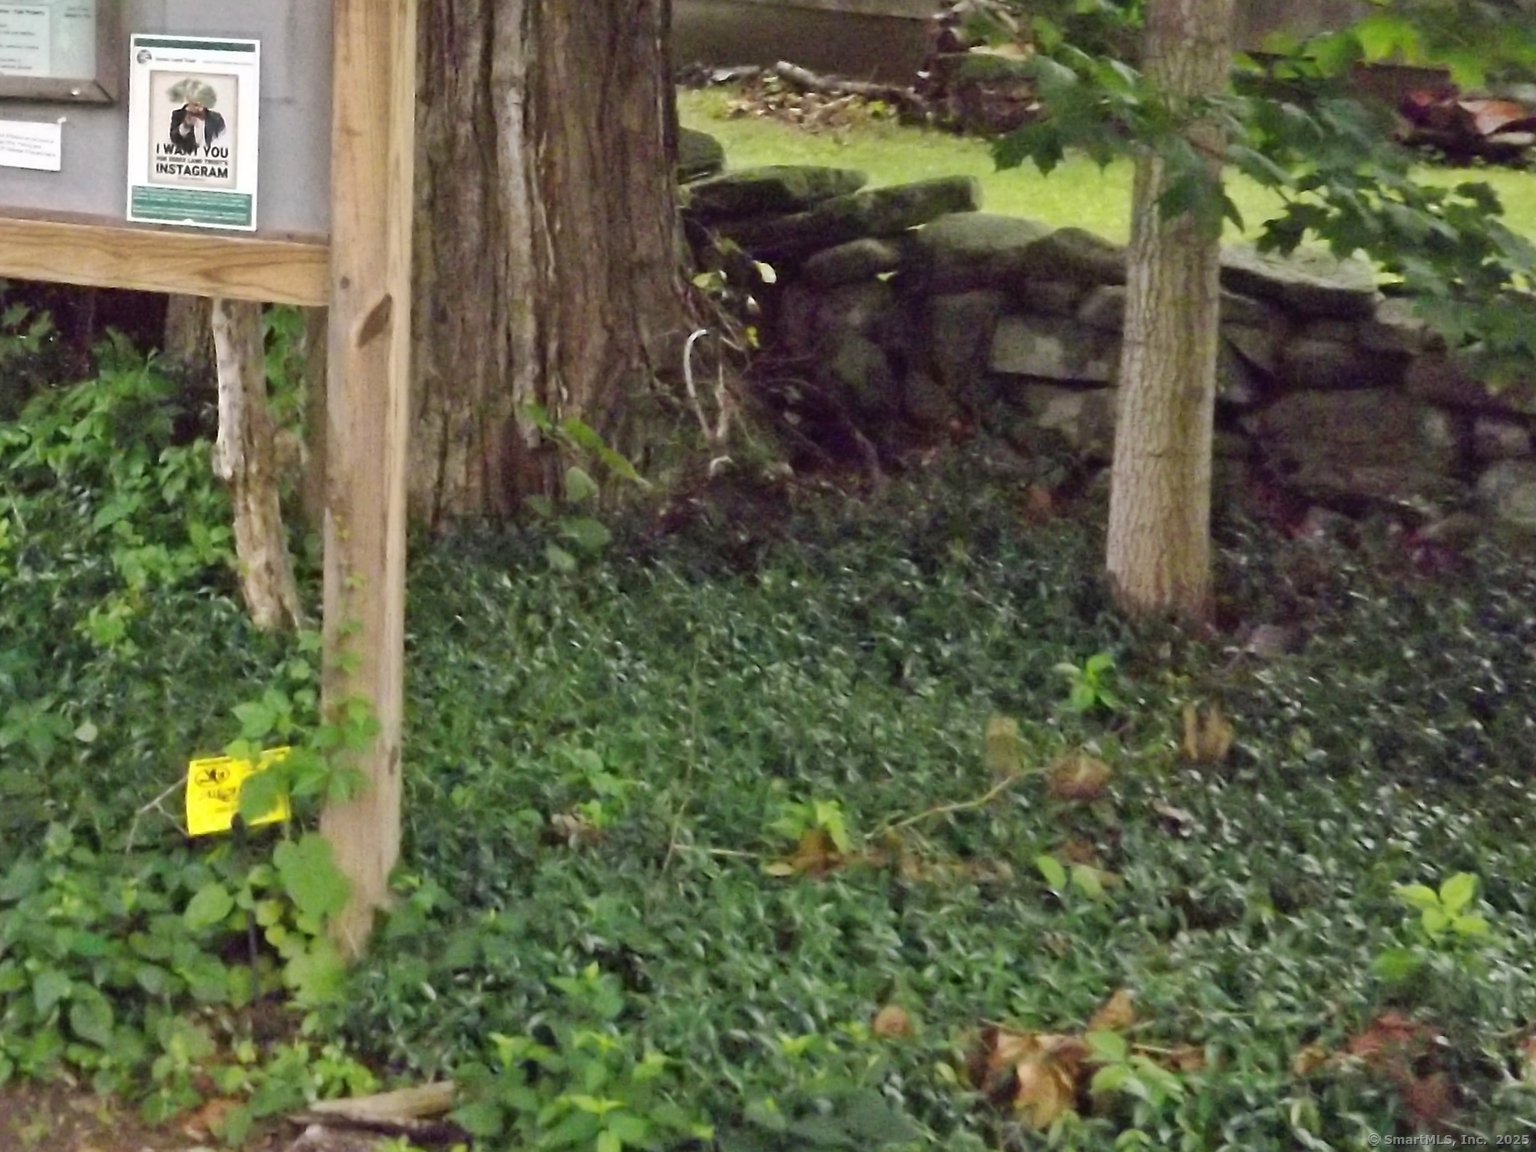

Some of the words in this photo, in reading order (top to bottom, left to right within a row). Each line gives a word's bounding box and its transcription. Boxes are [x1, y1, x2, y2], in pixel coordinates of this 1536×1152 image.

[156, 143, 160, 154] I
[203, 146, 229, 159] YOU
[155, 163, 228, 178] INSTAGRAM
